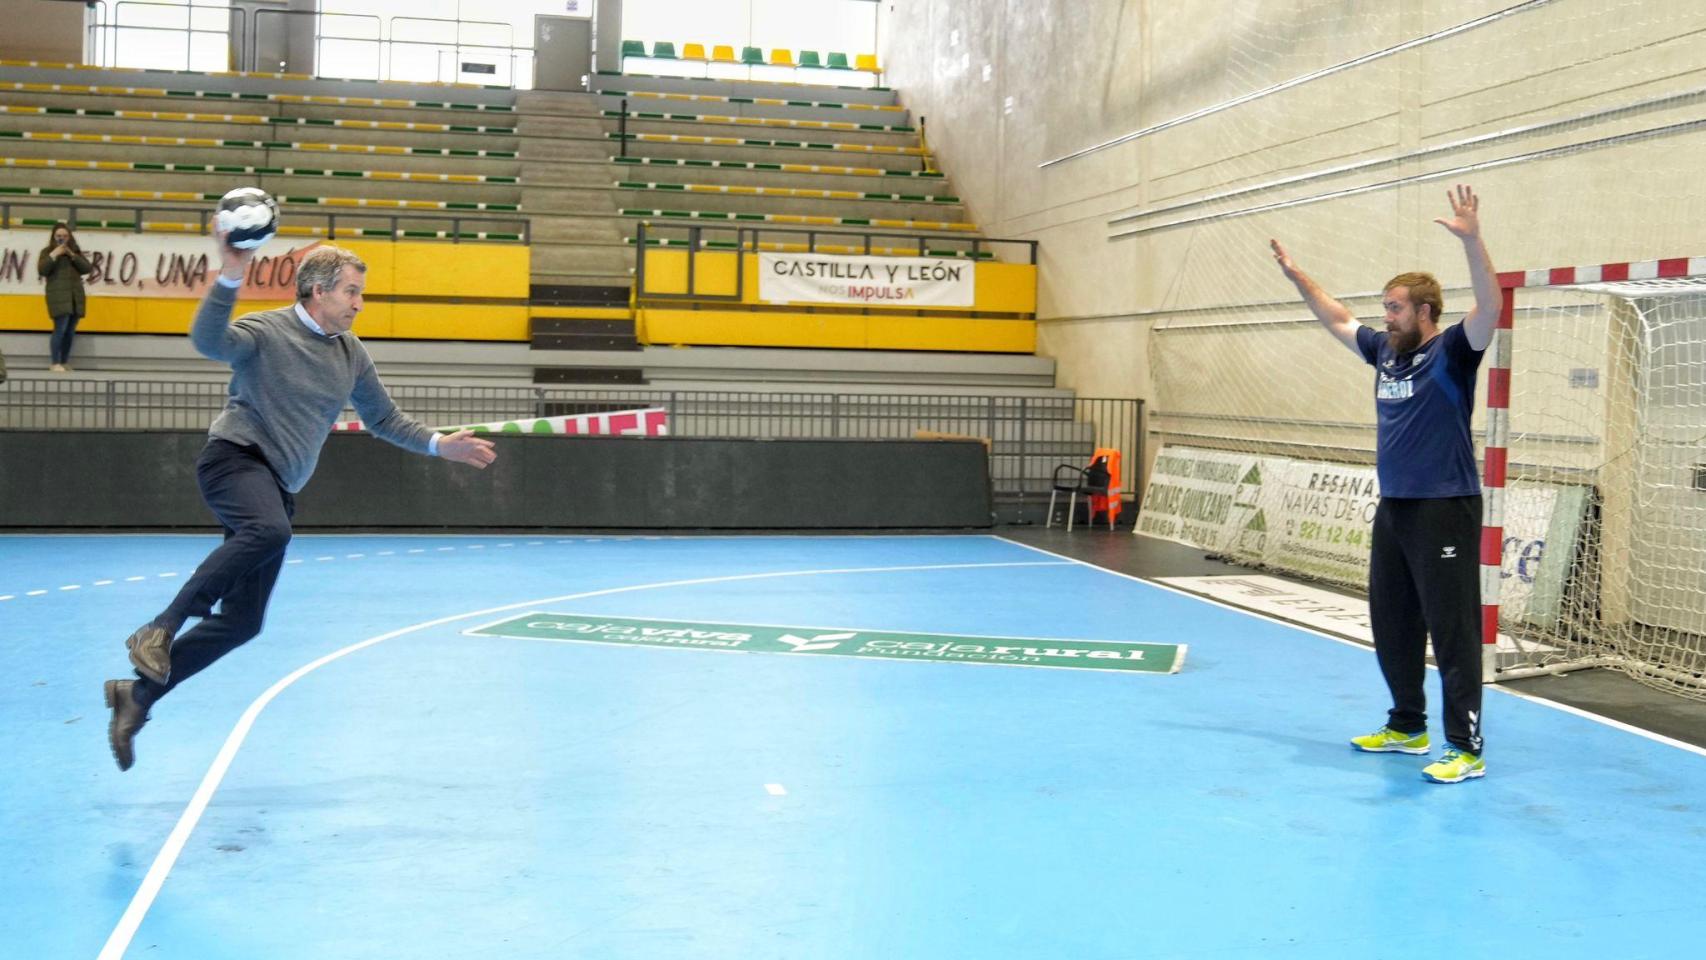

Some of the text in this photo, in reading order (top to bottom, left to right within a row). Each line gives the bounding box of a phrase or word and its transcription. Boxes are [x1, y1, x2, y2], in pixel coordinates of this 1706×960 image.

[155, 252, 208, 288] UNA
[774, 260, 961, 283] CASTILLA Y LEÓN
[818, 285, 915, 300] NOS IMPULSA
[1308, 472, 1380, 498] RESINA
[1281, 492, 1331, 517] NAVAS
[1334, 497, 1358, 520] DE
[1299, 520, 1321, 539] 921
[1327, 526, 1343, 544] 12
[527, 621, 752, 640] cajaviva
[864, 640, 1147, 660] cajarural
